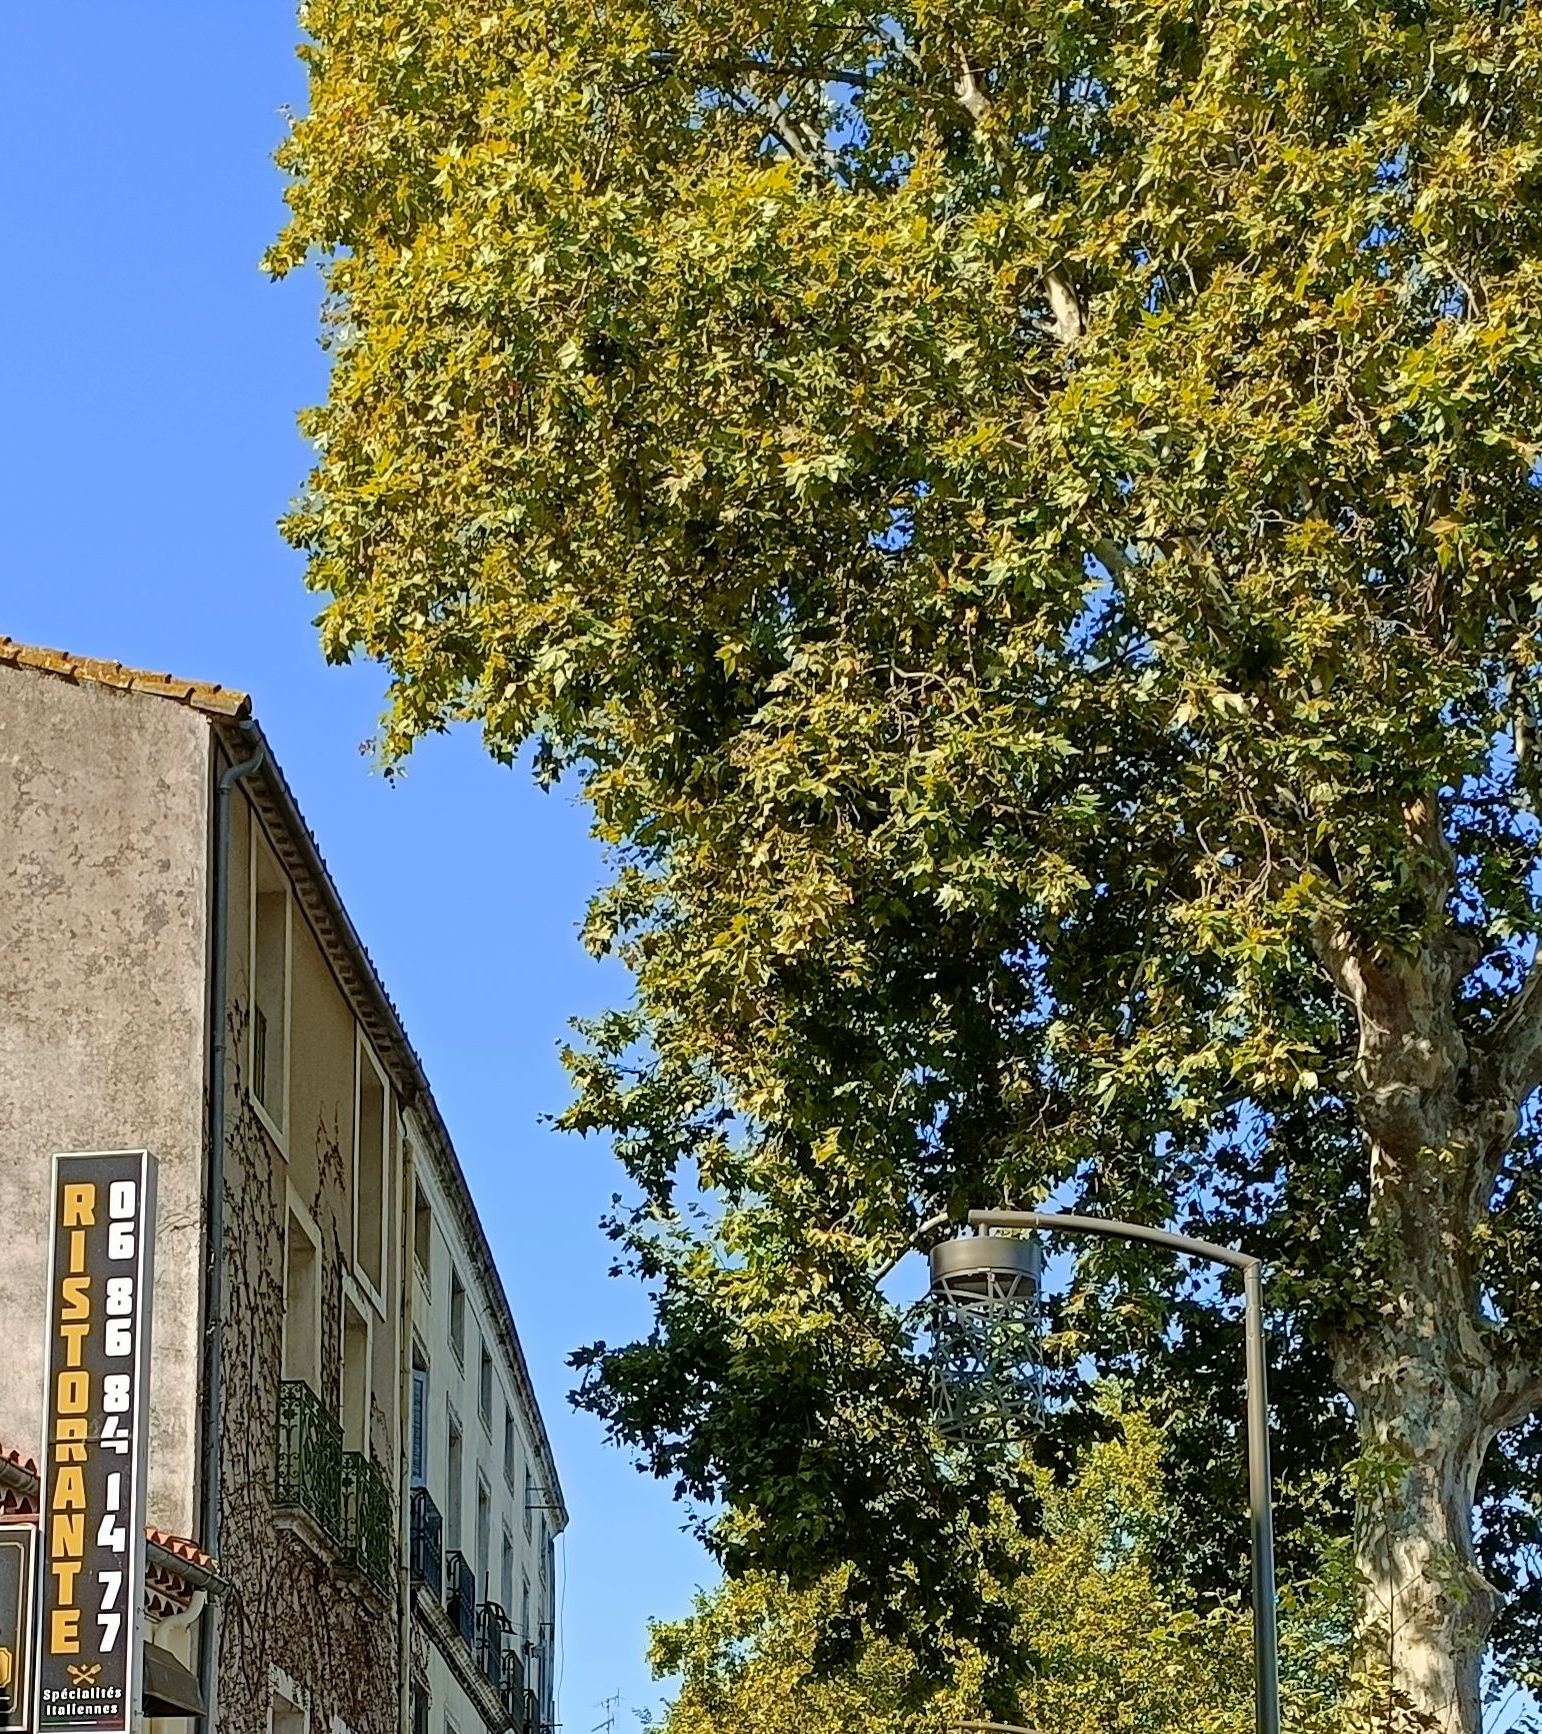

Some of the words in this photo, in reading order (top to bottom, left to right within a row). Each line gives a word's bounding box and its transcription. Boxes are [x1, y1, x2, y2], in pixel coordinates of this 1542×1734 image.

[107, 1180, 137, 1260] 06
[104, 1276, 134, 1358] 86
[49, 1181, 96, 1655] RISTORANTE
[96, 1472, 126, 1553] 14
[96, 1569, 124, 1654] 77
[42, 1686, 122, 1702] Spécialités
[46, 1703, 118, 1716] Italiennes
